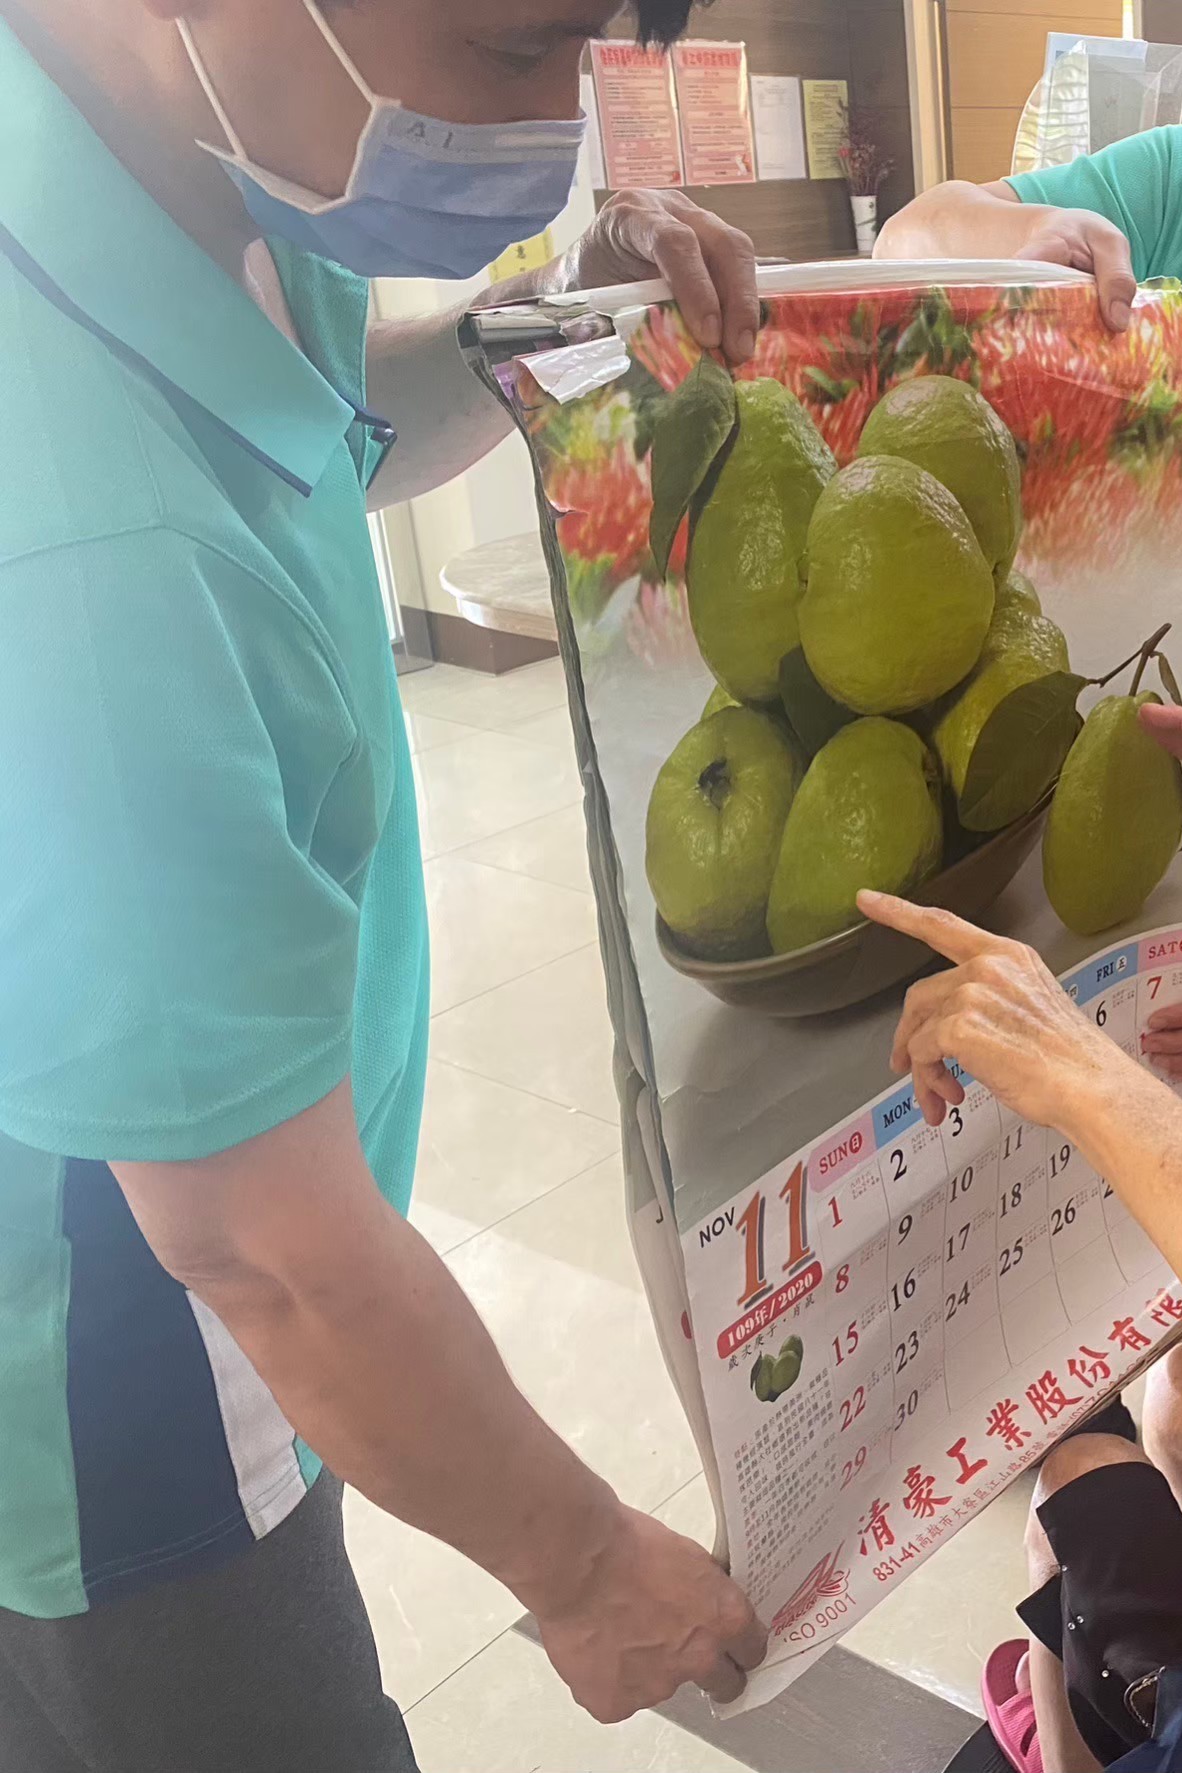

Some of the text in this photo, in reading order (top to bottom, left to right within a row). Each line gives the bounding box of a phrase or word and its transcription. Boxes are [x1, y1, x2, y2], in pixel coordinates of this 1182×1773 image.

[818, 1142, 848, 1174] SUN
[883, 1097, 911, 1128] MON
[1096, 962, 1114, 982] FRI
[1148, 941, 1178, 960] SAT
[828, 1196, 843, 1228] 1
[890, 1149, 907, 1181] 2
[949, 1107, 963, 1137] 3
[1096, 1000, 1107, 1027] 6
[1147, 976, 1162, 1000] 7
[699, 1206, 735, 1248] NOV
[735, 1161, 814, 1307] 11
[832, 1320, 859, 1366] 15
[891, 1268, 916, 1312] 16
[946, 1222, 971, 1262] 17
[1000, 1183, 1022, 1218] 18
[1050, 1145, 1070, 1178] 19
[835, 1125, 1023, 1293] 8 9 10 11
[726, 1272, 814, 1348] 109年/2020
[840, 1386, 866, 1432] 22
[895, 1331, 919, 1374] 23
[945, 1280, 970, 1322] 24
[1000, 1237, 1023, 1276] 25
[1051, 1198, 1076, 1236] 26
[840, 1390, 919, 1491] 29 30
[783, 1622, 816, 1643] SO
[815, 1593, 856, 1627] 9001
